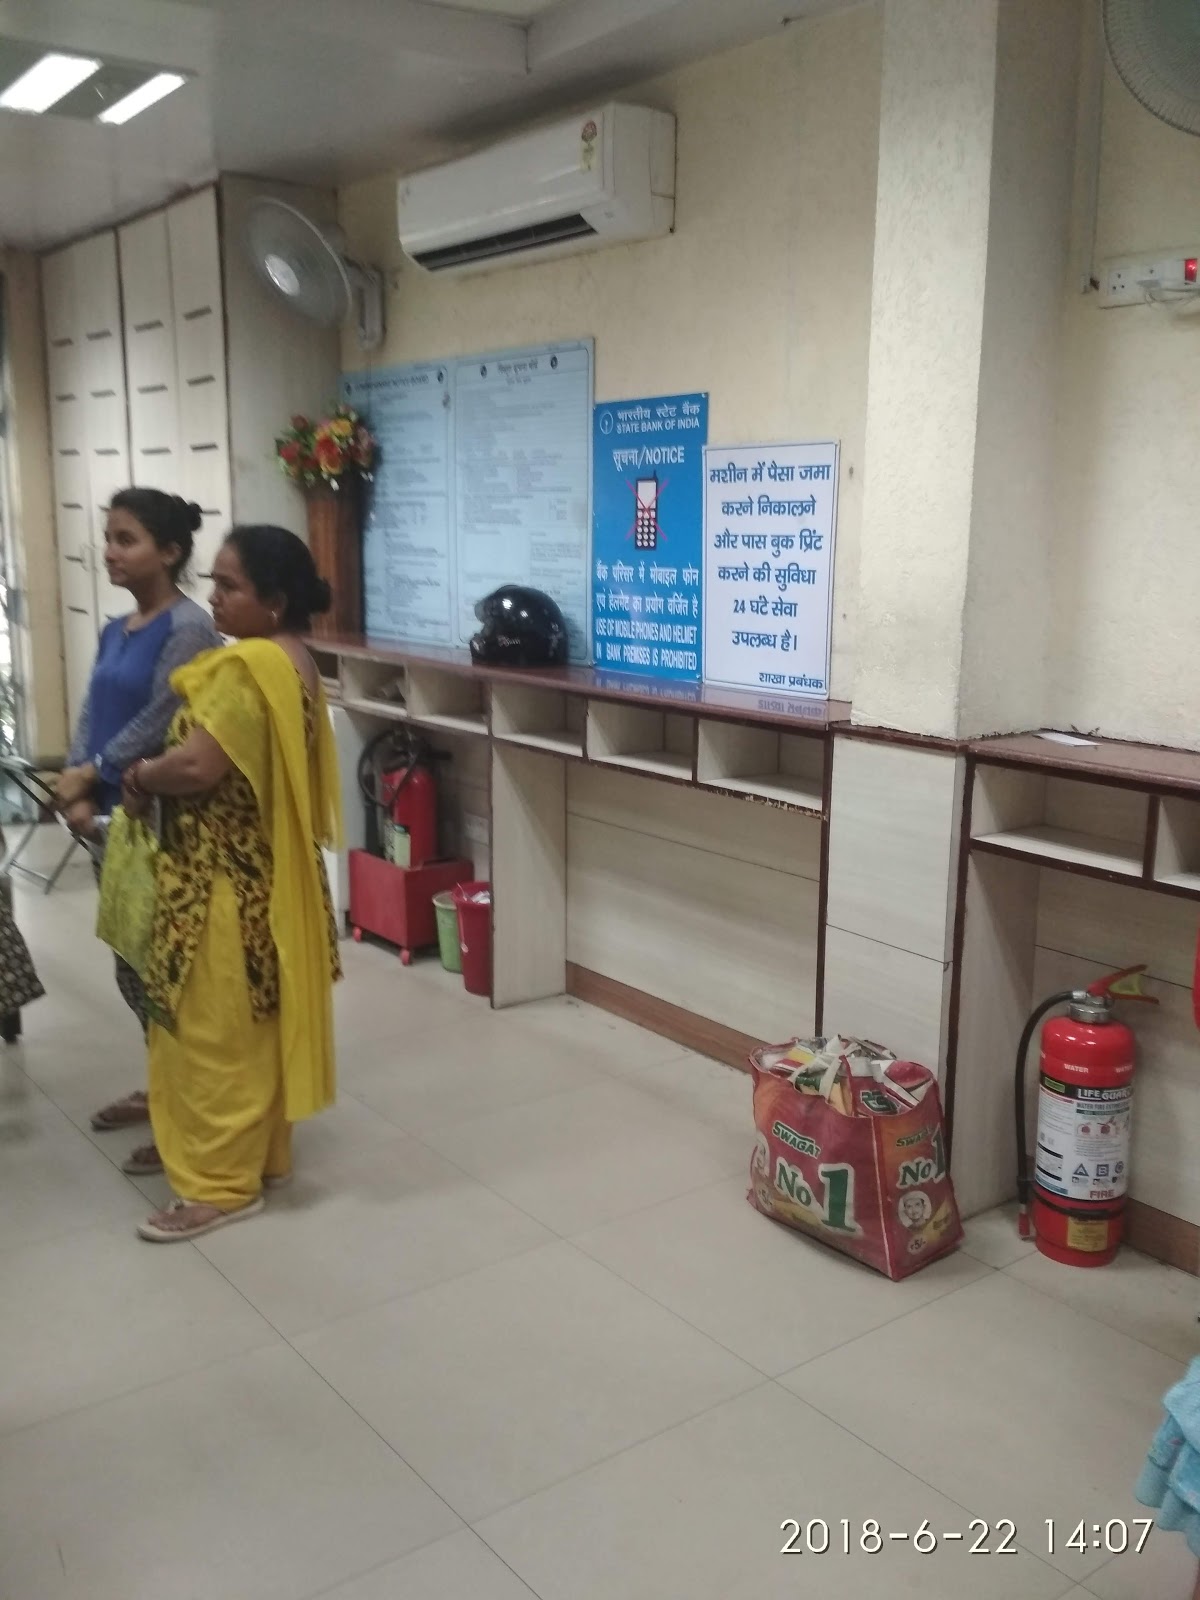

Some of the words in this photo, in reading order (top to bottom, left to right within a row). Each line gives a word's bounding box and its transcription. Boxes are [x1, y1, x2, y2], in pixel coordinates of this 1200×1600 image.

[617, 405, 651, 421] भारतीय
[656, 403, 677, 418] स्टेट
[682, 400, 700, 416] बैंक
[617, 422, 640, 434] STATE
[641, 421, 663, 432] BANK
[665, 420, 675, 430] OF
[678, 418, 700, 430] INDIA
[710, 462, 748, 483] मशीन
[751, 461, 766, 482] में
[768, 460, 795, 482] पैसा
[798, 465, 831, 480] जमा
[721, 496, 754, 516] करने
[757, 494, 816, 517] निकालने
[714, 528, 739, 549] और
[741, 535, 768, 549] पास
[771, 535, 795, 558] बुक
[799, 528, 823, 553] प्रिंट
[596, 559, 608, 581] बैंक
[612, 559, 634, 583] परिसर
[650, 561, 677, 588] मोबाइल
[683, 562, 699, 586] फोन
[718, 562, 750, 582] करने
[753, 561, 771, 582] की
[775, 563, 816, 591] सुविधा
[596, 587, 606, 612] एवं
[608, 588, 629, 612] हेलमेट
[632, 595, 642, 612] का
[645, 591, 664, 614] प्रयोग
[667, 591, 688, 616] वर्जित
[692, 593, 698, 618] है
[733, 599, 746, 613] 24
[750, 595, 769, 615] घंटे
[772, 596, 798, 617] सेवा
[596, 617, 606, 636] USE
[607, 618, 615, 636] OF
[615, 619, 635, 639] MOBILE
[635, 621, 658, 641] PHONES
[659, 624, 672, 642] AND
[672, 625, 697, 645] HELMET
[731, 631, 777, 649] उपलब्ध
[596, 642, 602, 659] IN
[606, 642, 621, 661] BANK
[623, 644, 650, 666] PREMISES
[652, 648, 659, 666] IS
[661, 648, 697, 671] PROHIBITED
[759, 672, 785, 685] शाखा
[788, 674, 823, 689] प्रबंधक
[1064, 1063, 1089, 1074] WATER
[1078, 1088, 1101, 1100] LIFE
[773, 1121, 820, 1158] SWAGAT
[821, 1168, 856, 1232] 1
[1090, 1189, 1114, 1199] FIRE
